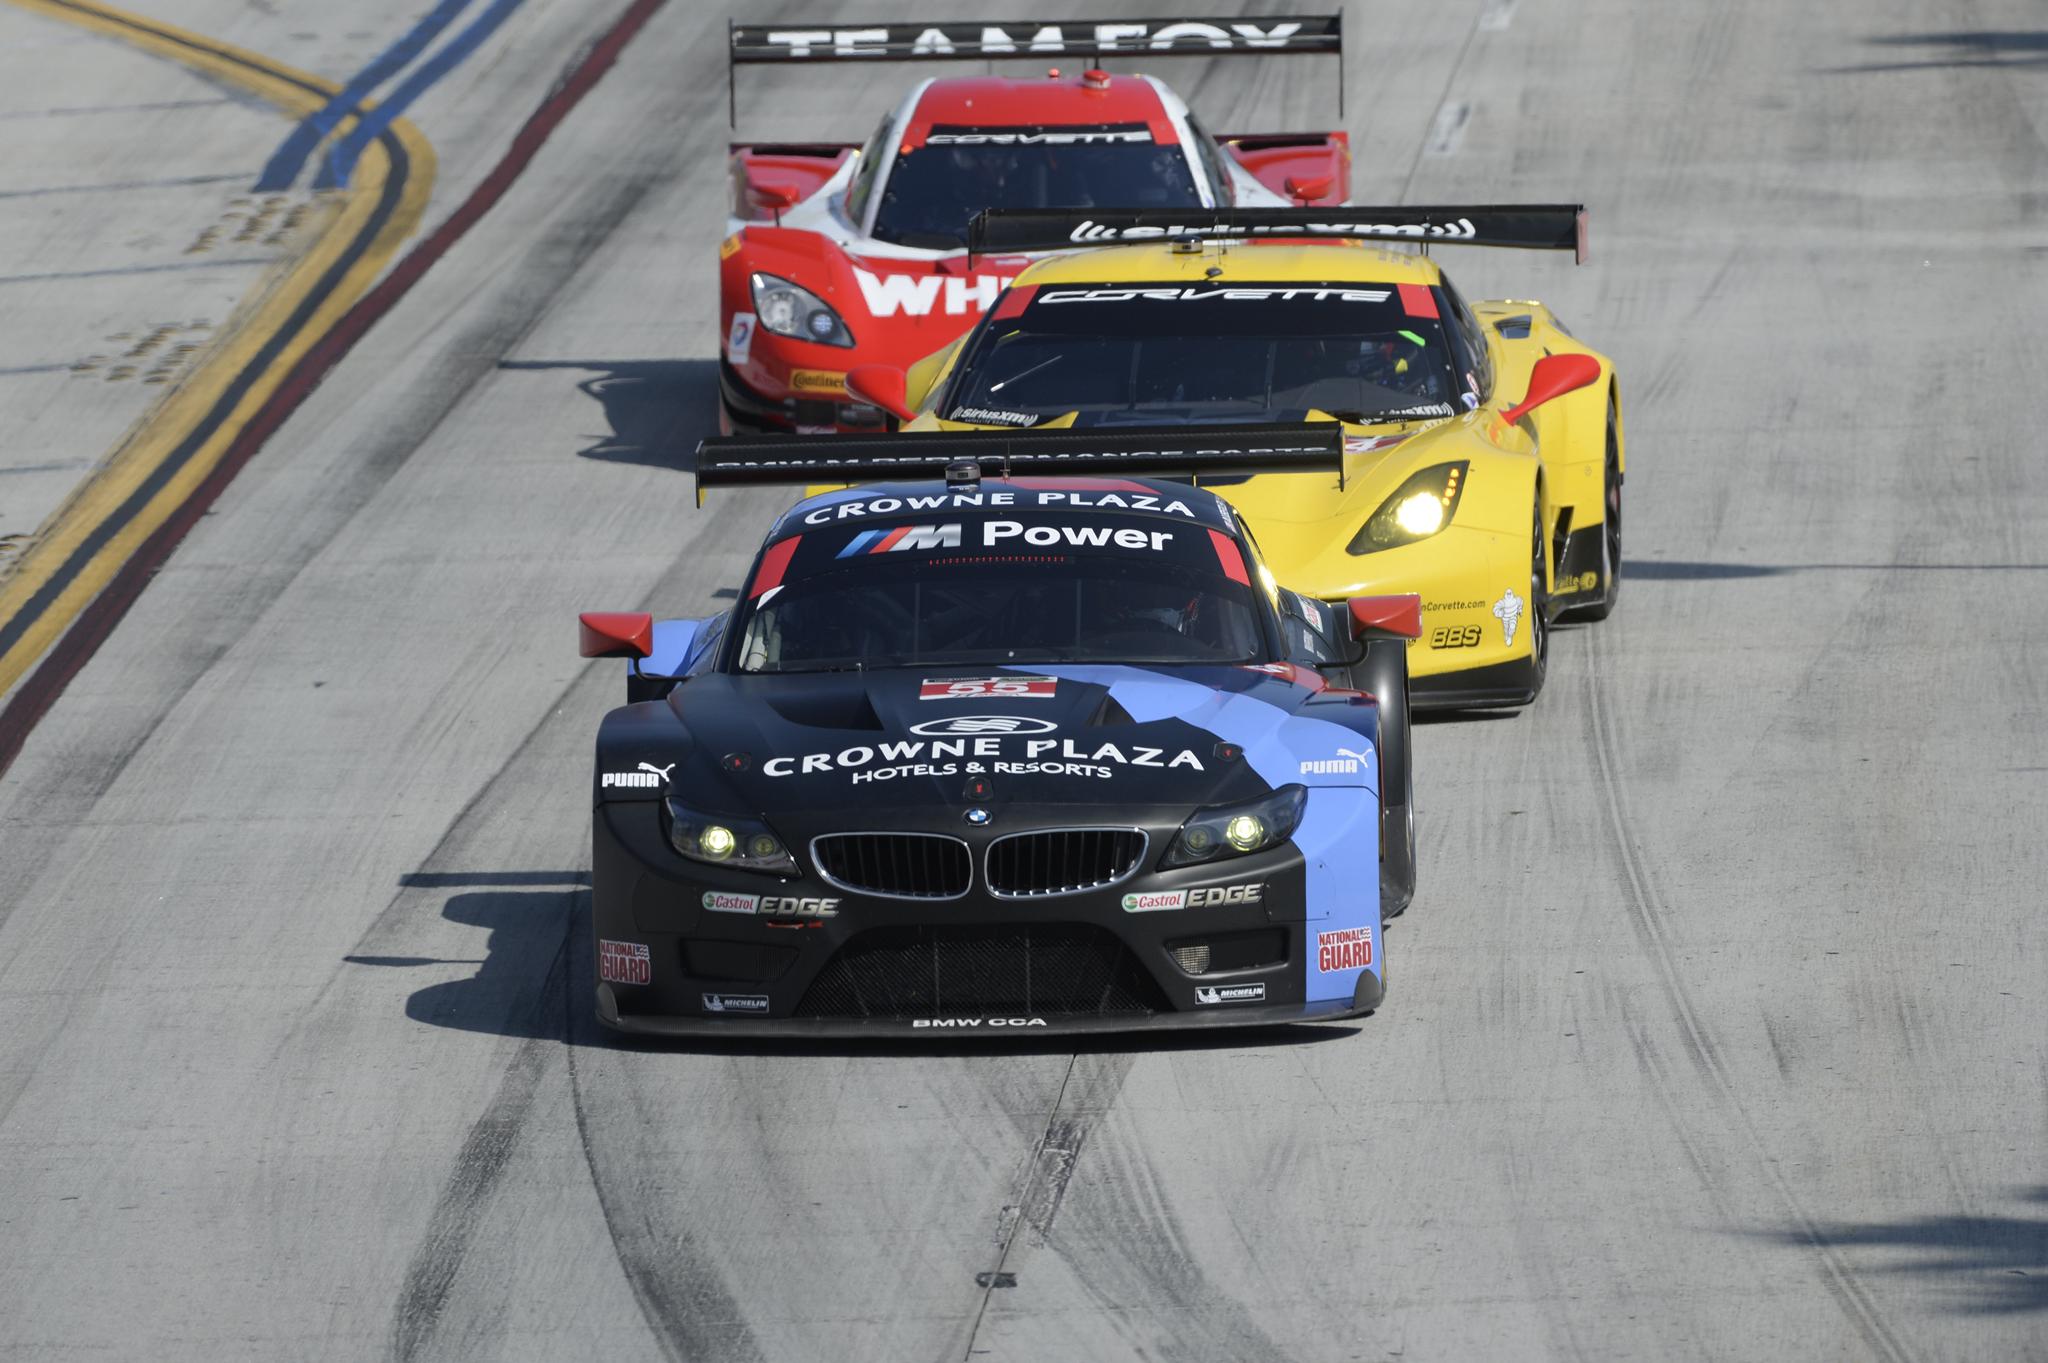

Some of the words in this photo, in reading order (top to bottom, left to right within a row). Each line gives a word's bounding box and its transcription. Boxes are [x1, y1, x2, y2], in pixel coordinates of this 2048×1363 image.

[925, 131, 1152, 144] CORVETTE
[1037, 288, 1392, 304] CORVETTE
[804, 492, 1014, 525] CROWNE
[1038, 491, 1196, 518] PLAZA
[983, 520, 1174, 552] Power
[1430, 625, 1482, 649] BBS
[946, 681, 1030, 695] 55
[762, 737, 1001, 778] CROWNE
[1026, 738, 1206, 772] PLAZA
[851, 761, 962, 785] HOTELS
[965, 761, 987, 775] &
[994, 761, 1113, 779] RESORTS
[1300, 760, 1358, 774] PUMA
[602, 772, 660, 788] PUMA
[1138, 892, 1182, 909] Castrol
[1185, 883, 1265, 908] EDGE
[714, 894, 754, 911] Castrol
[757, 896, 840, 918] EDGE
[1318, 929, 1361, 946] NATIONAL
[600, 940, 637, 957] NATIONAL
[1318, 940, 1373, 972] GUARD
[600, 956, 650, 985] GUARD
[1220, 986, 1264, 997] MICHELIN
[724, 999, 768, 1008] MICHELIN
[912, 1018, 983, 1028] BMW
[987, 1018, 1048, 1027] CCA
